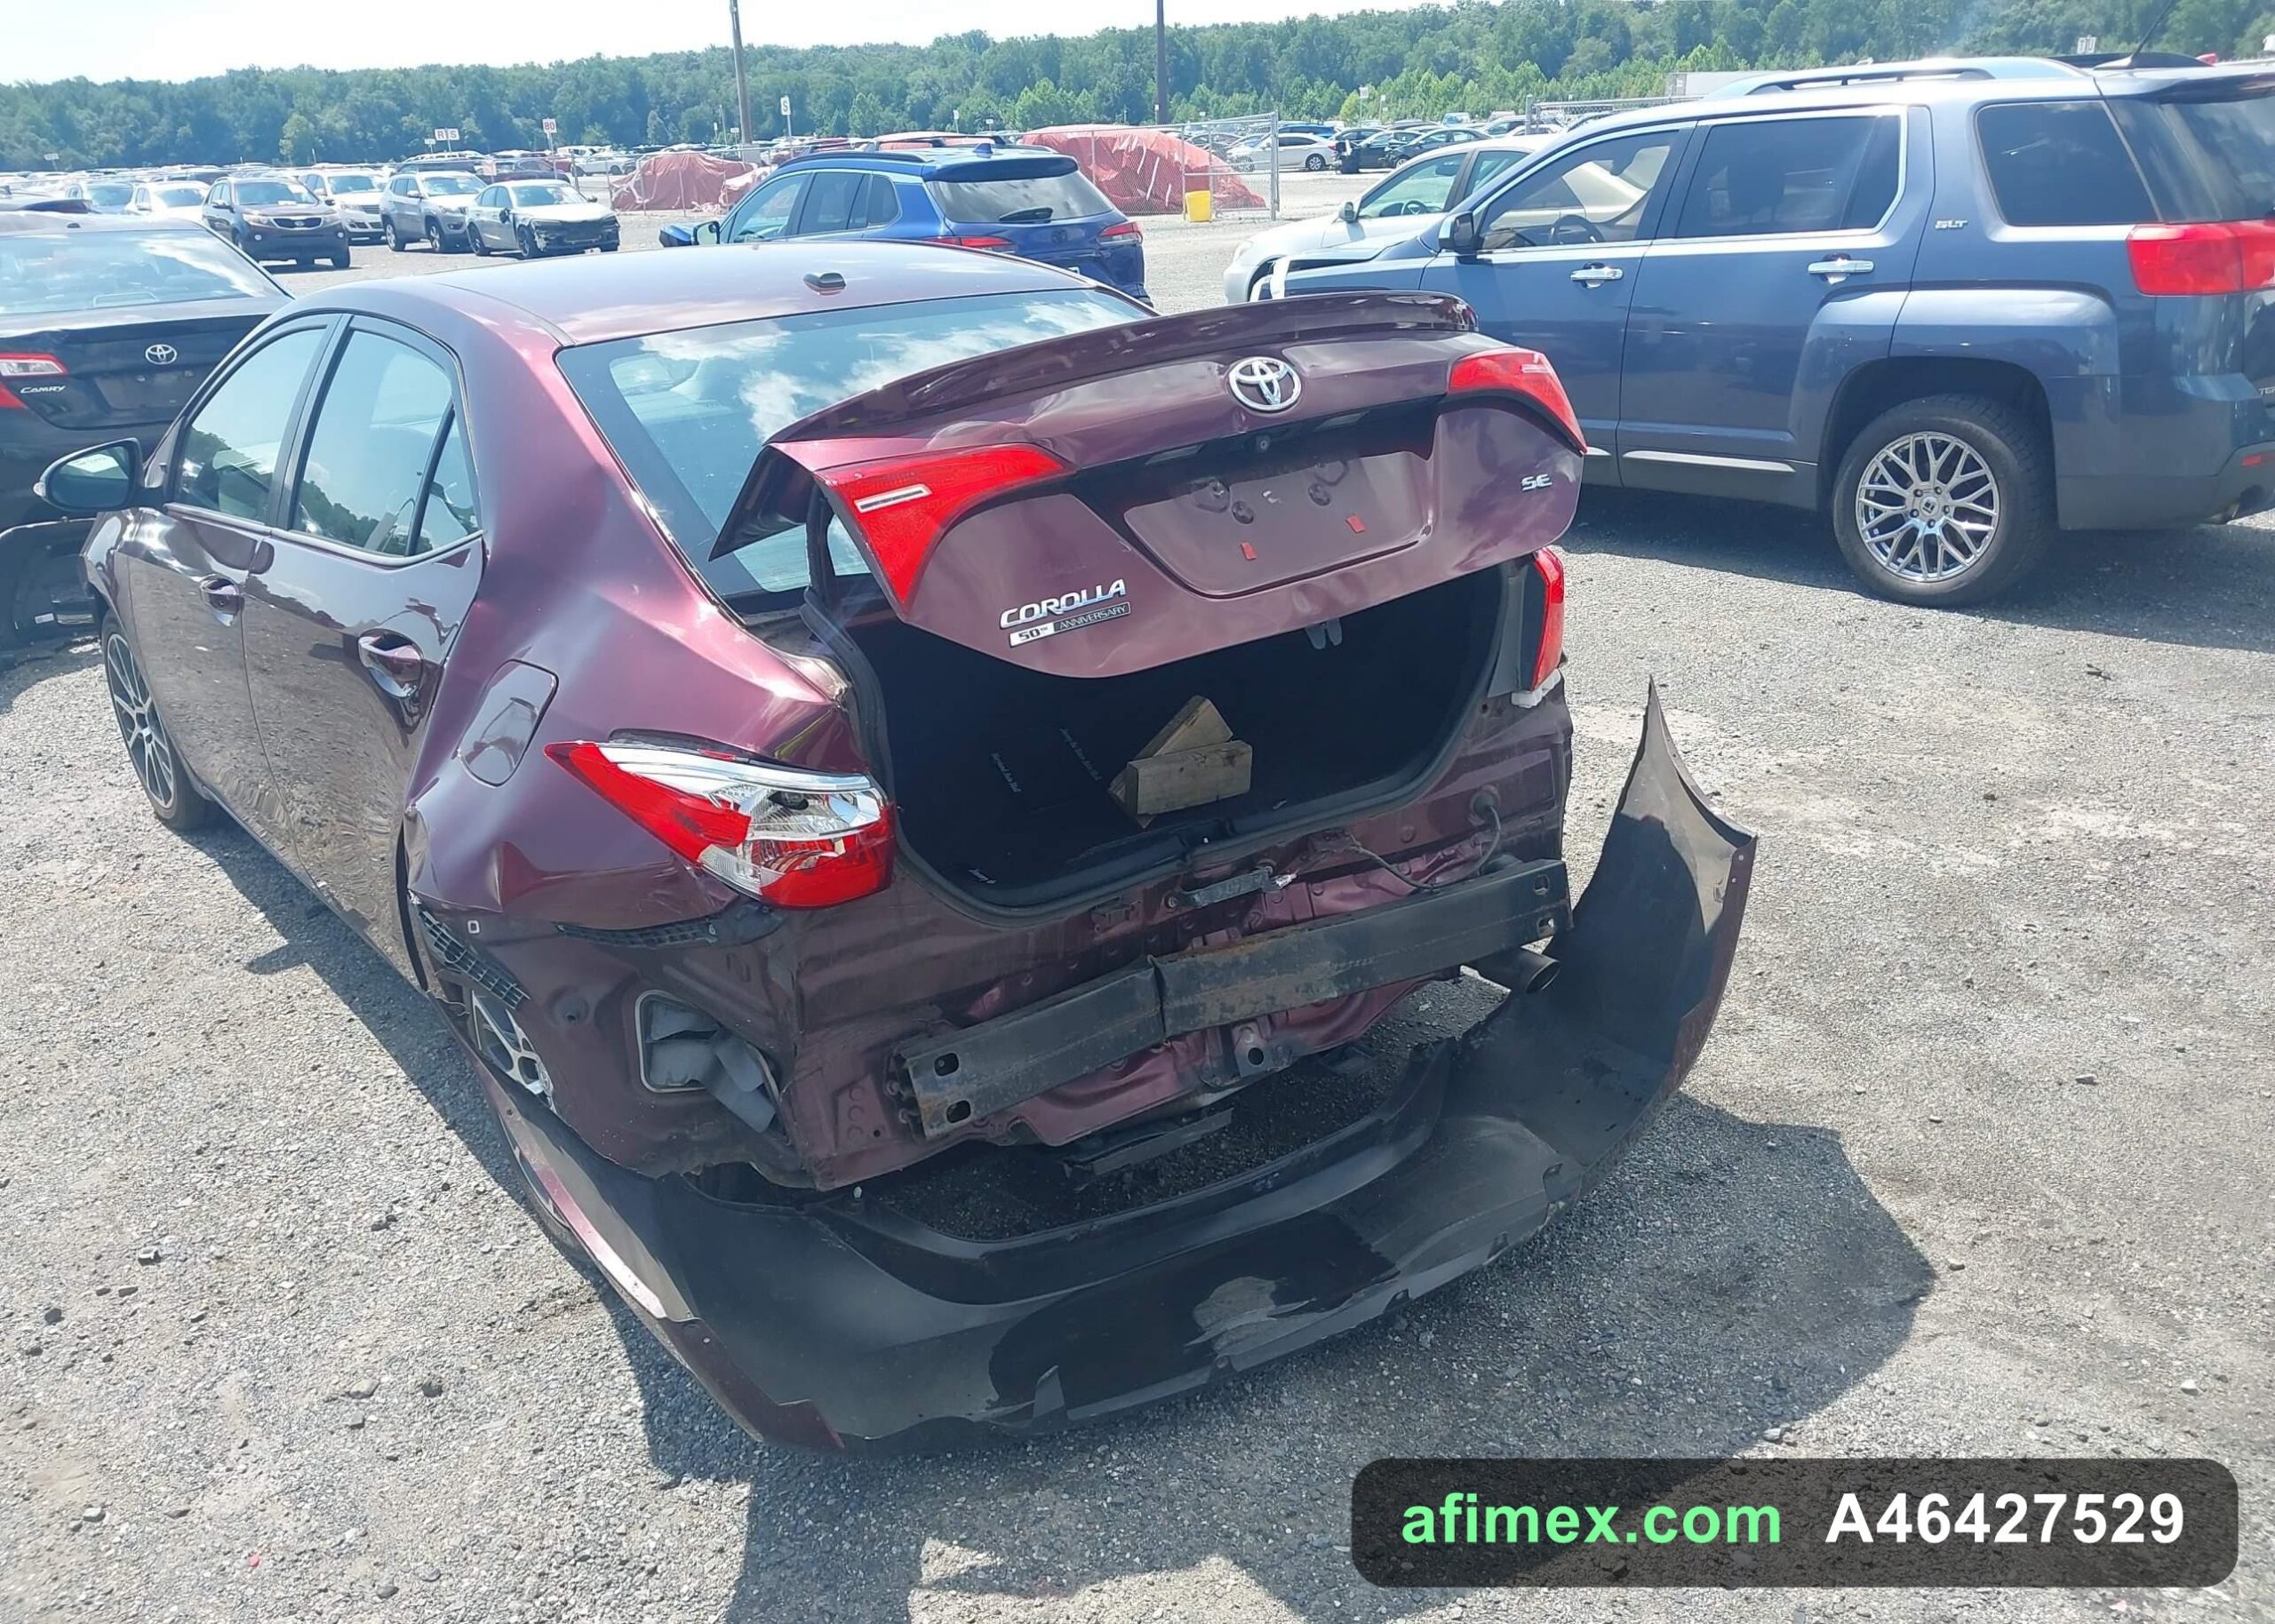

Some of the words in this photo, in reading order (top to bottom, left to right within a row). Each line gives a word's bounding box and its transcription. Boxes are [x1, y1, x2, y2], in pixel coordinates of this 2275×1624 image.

[1935, 219, 1968, 229] SLT
[20, 385, 67, 394] CAMRY
[1521, 474, 1553, 491] SE
[1000, 578, 1127, 629] COROLLA
[1059, 604, 1127, 630] ANNIVERSARY
